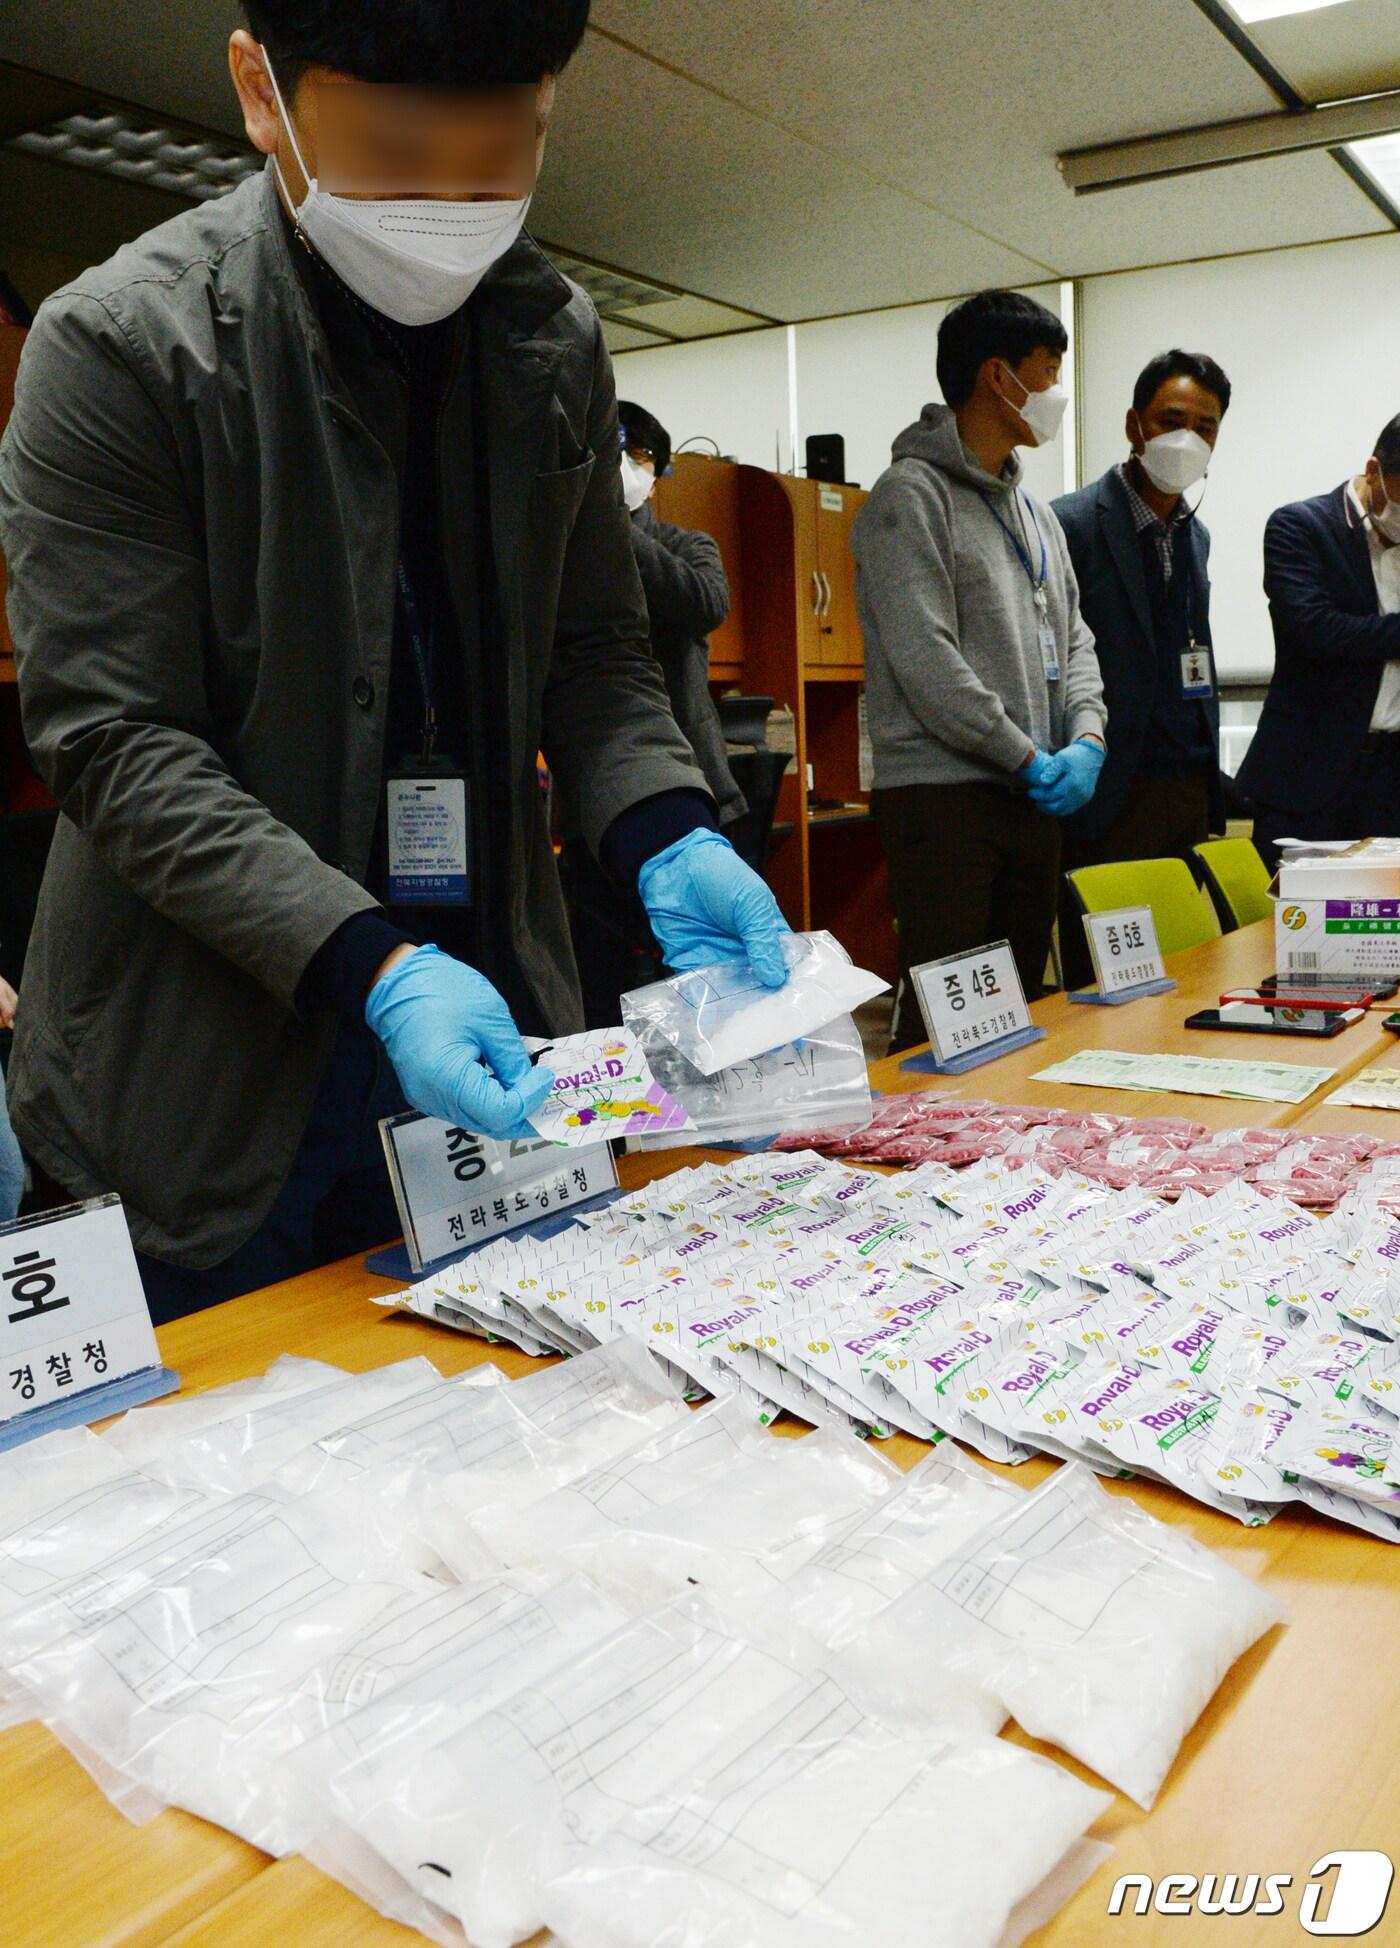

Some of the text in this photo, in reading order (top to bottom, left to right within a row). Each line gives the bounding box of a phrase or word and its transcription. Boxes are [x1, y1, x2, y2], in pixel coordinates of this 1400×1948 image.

[1106, 922, 1144, 956] 증 5호
[943, 963, 1001, 1012] 증 4호
[951, 1010, 1017, 1049] 전라북도경찰청
[552, 1059, 624, 1091] oyal-D
[446, 1127, 486, 1182] 증
[771, 1164, 826, 1183] Royal-D
[447, 1166, 589, 1243] 전라북도경찰청
[732, 1197, 785, 1223] Royal-D
[675, 1231, 718, 1257] oyal-D
[845, 1216, 900, 1244] Royal-D
[1258, 1216, 1313, 1242] Royal-D
[2, 1250, 70, 1324] 호
[898, 1285, 958, 1314] Royal-D
[845, 1316, 912, 1355] Royal-D
[1171, 1310, 1223, 1357] Royal-D
[9, 1339, 108, 1400] 경찰청
[1081, 1364, 1142, 1416] Royal-D
